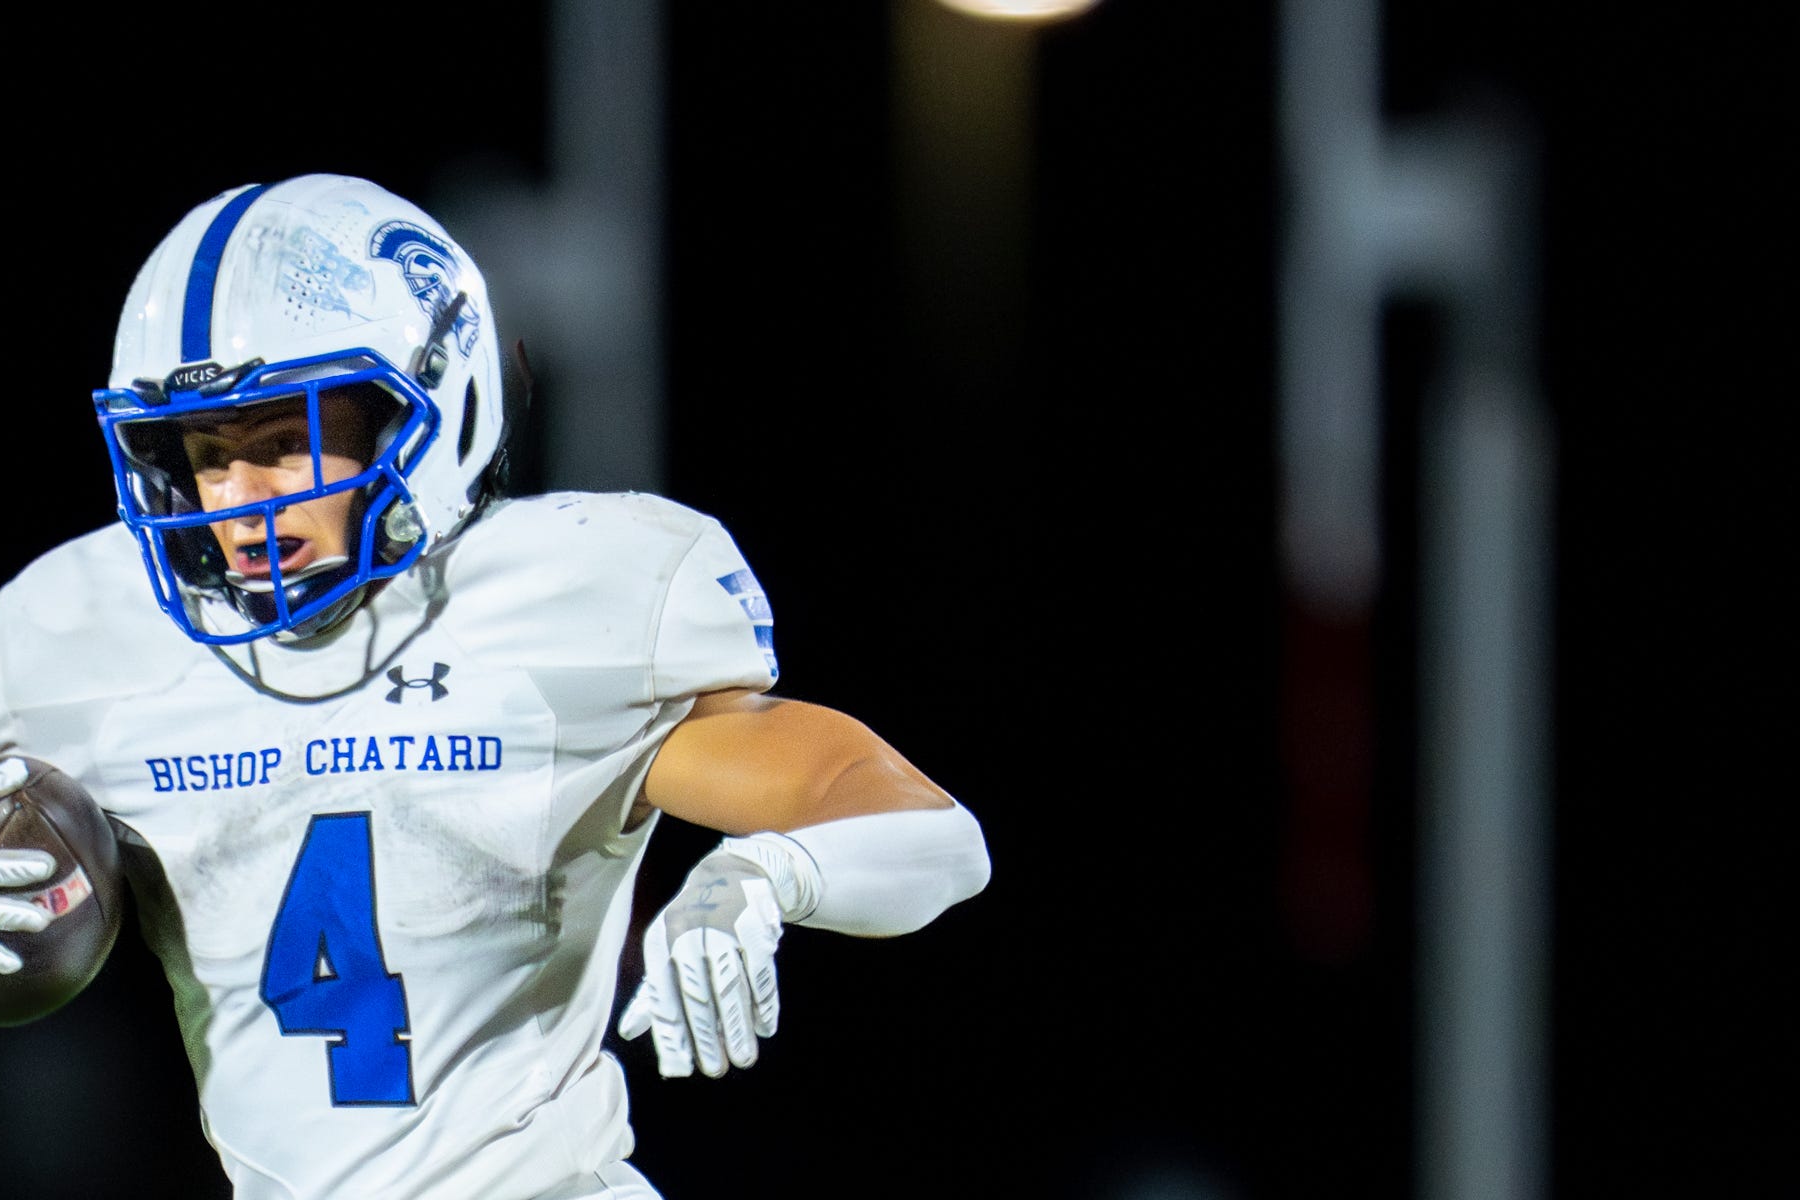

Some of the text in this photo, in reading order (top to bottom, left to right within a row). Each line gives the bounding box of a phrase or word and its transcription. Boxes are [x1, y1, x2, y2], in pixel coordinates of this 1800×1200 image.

[174, 366, 218, 386] VICIS
[145, 735, 503, 792] BISHOP CHATARD
[259, 810, 418, 1108] 4
